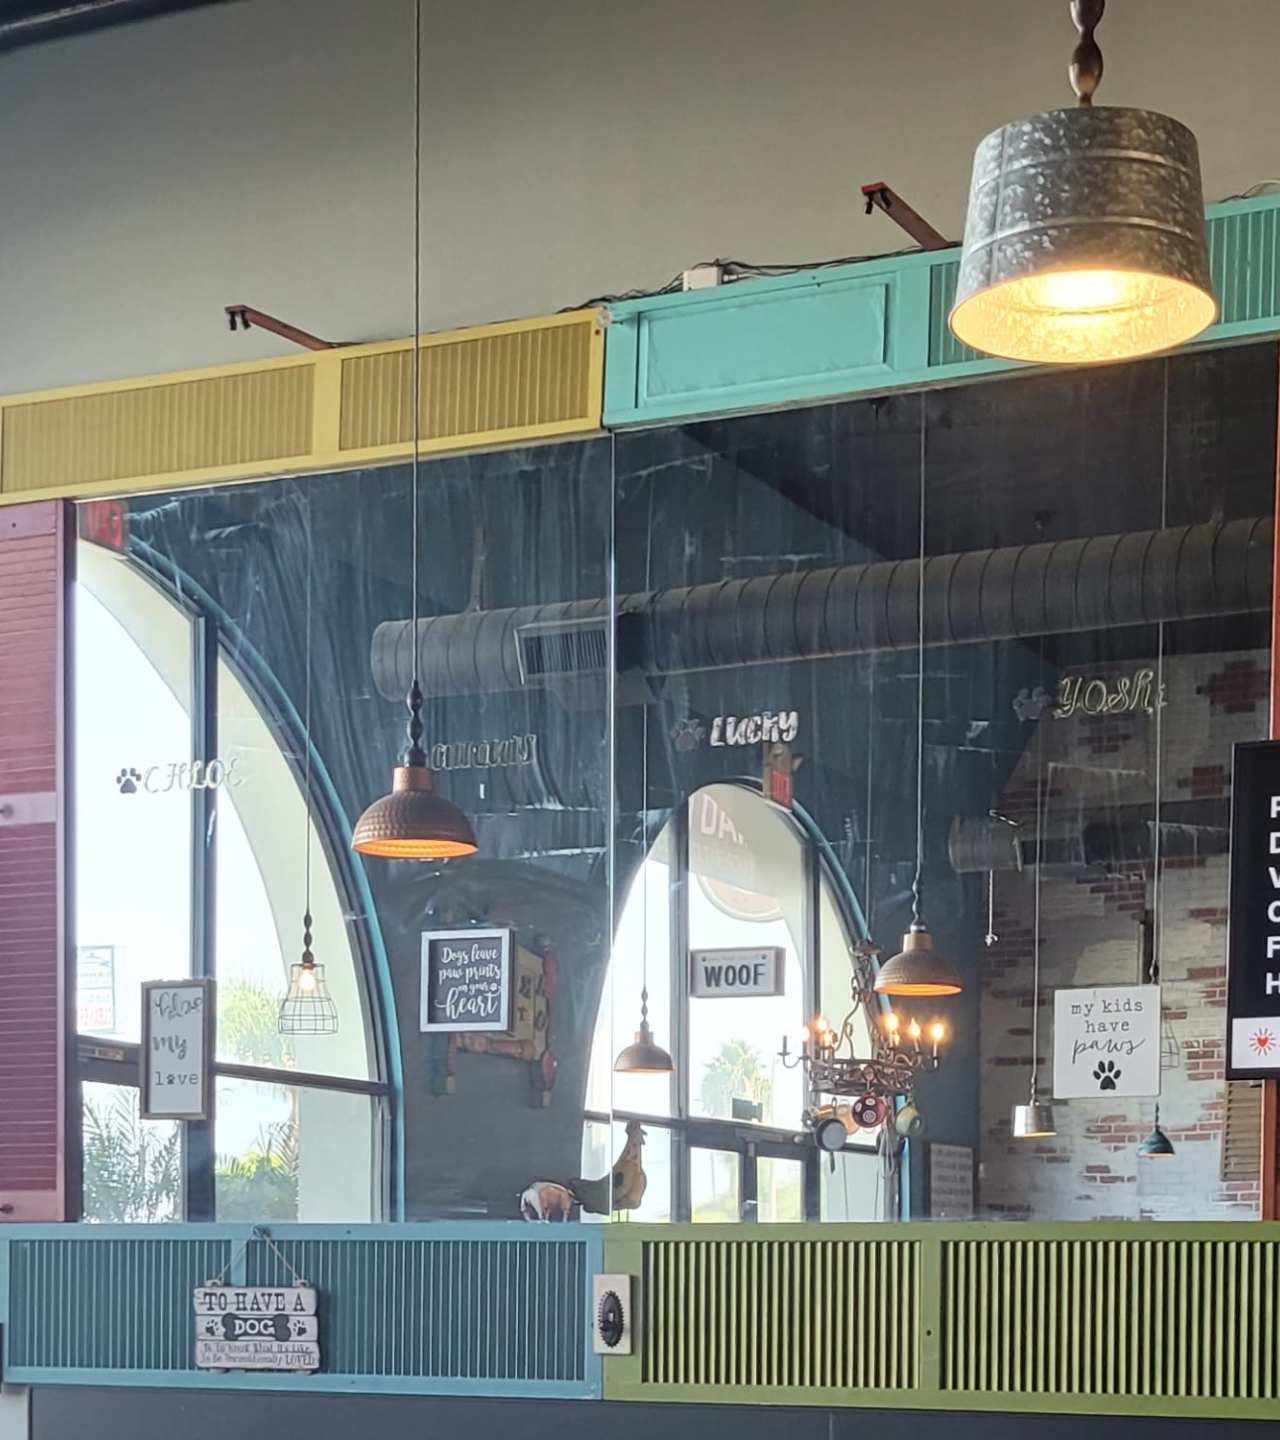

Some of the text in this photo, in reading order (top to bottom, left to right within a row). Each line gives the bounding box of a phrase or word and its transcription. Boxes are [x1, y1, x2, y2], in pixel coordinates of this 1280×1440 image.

[441, 943, 497, 966] Dogs leave
[439, 963, 500, 985] paw prints
[704, 963, 766, 987] WOOF
[435, 986, 500, 1019] heart
[1071, 997, 1143, 1017] my kids
[1085, 1019, 1129, 1034] have
[1072, 1037, 1146, 1064] paws
[203, 1292, 305, 1312] TO HAVE A
[234, 1319, 275, 1335] DOG
